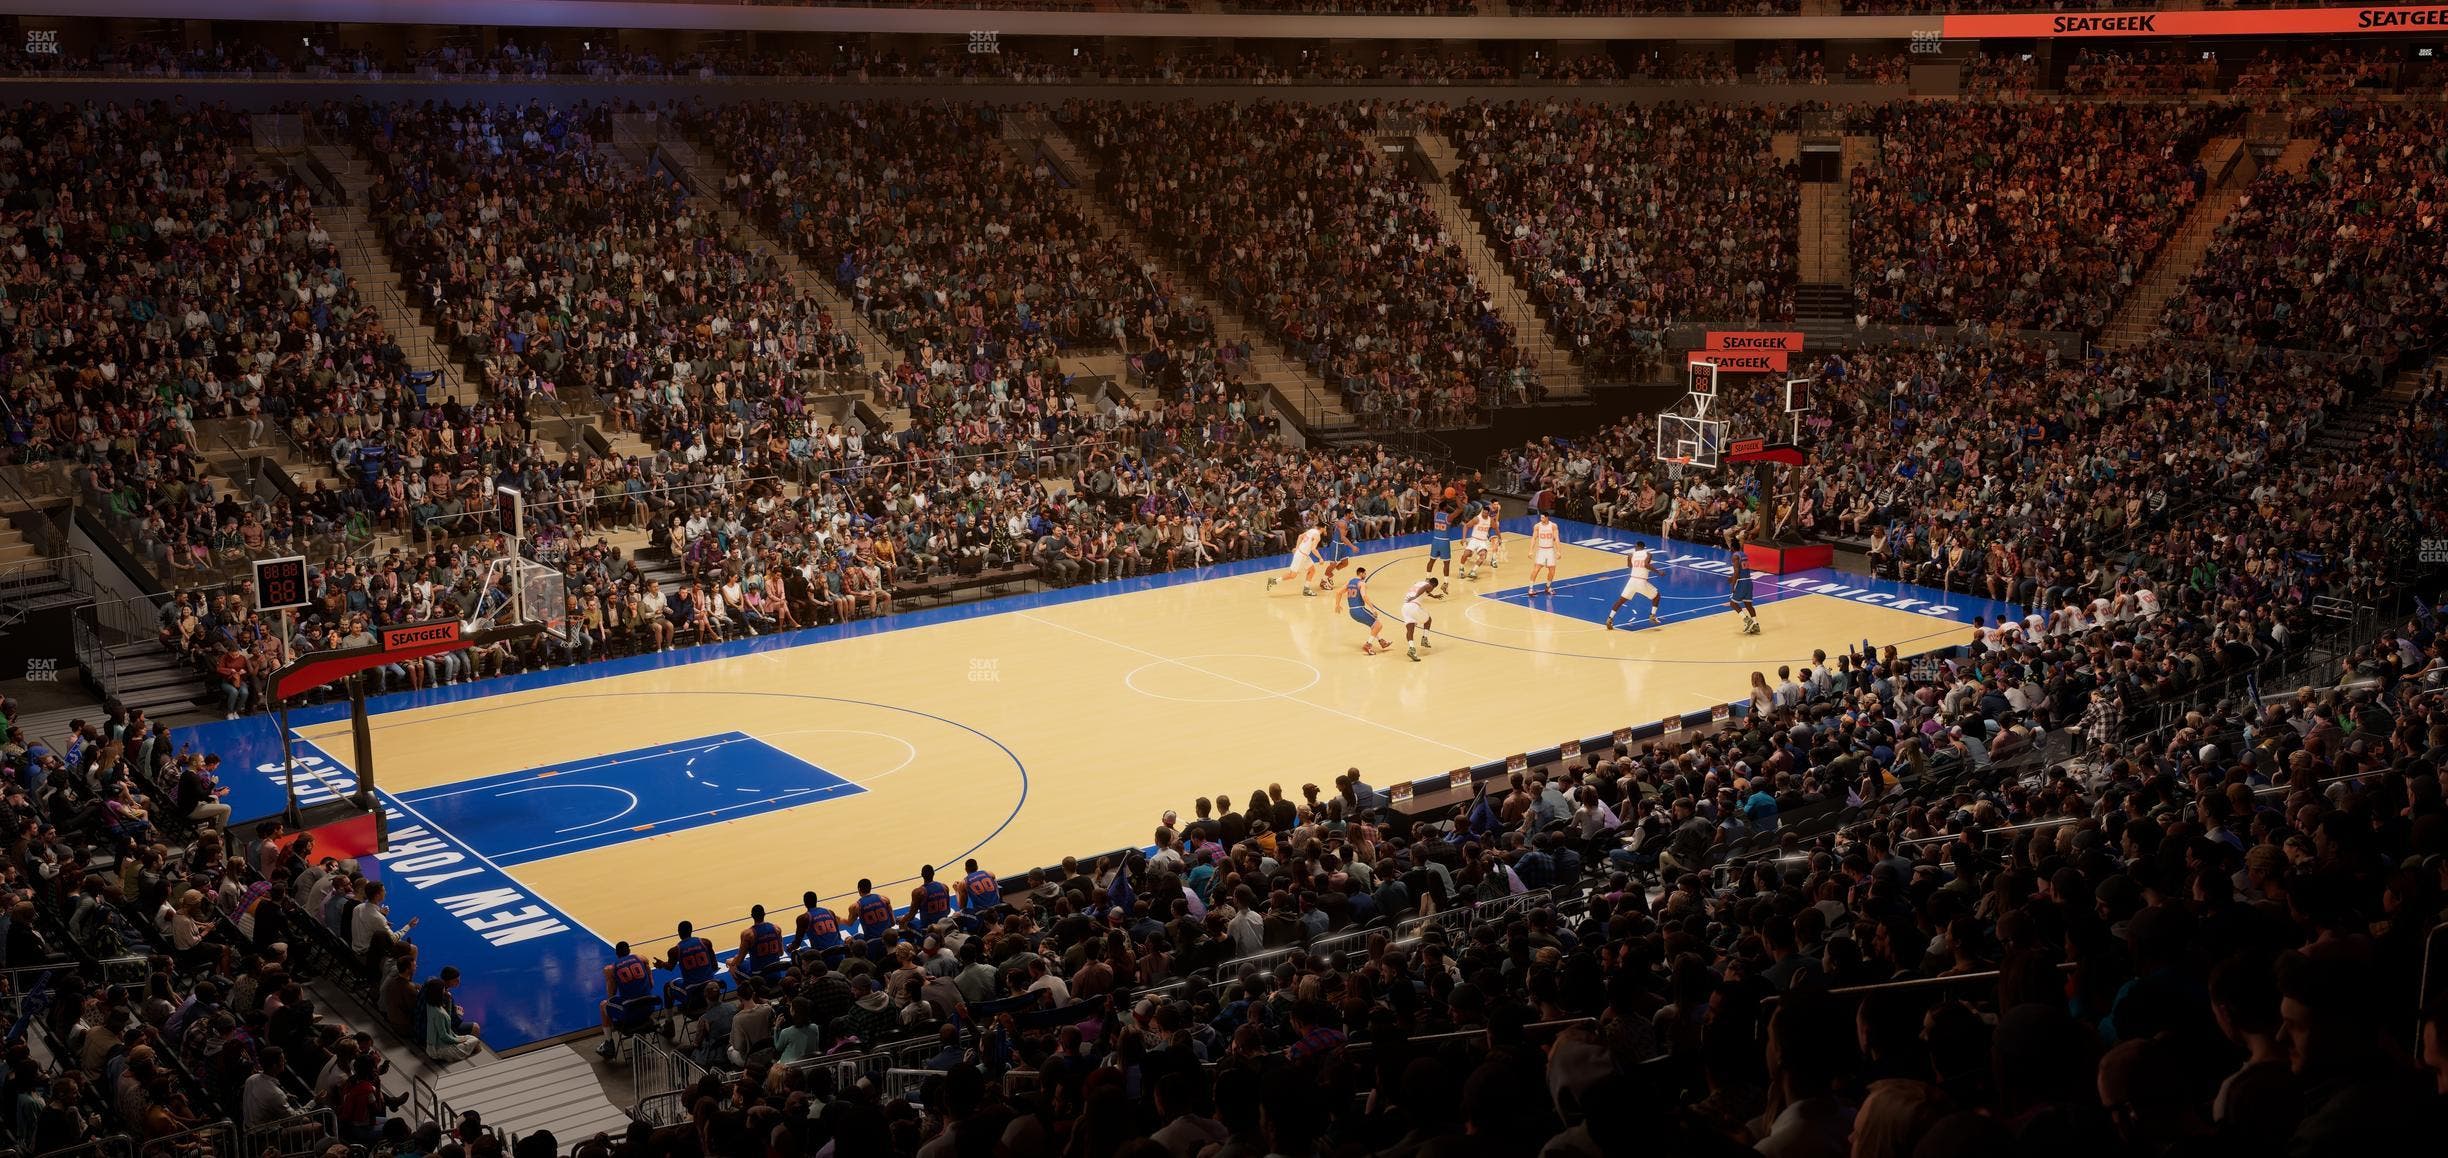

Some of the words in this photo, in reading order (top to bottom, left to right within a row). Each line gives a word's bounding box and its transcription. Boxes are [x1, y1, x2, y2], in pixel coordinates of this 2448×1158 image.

[2053, 15, 2156, 33] SEATGEEK
[1723, 337, 1787, 349] SEATGEEK
[269, 580, 296, 603] 88
[1776, 577, 1959, 616] KNICKS
[392, 626, 452, 646] SEATGEEK
[970, 877, 995, 895] 00
[433, 887, 571, 947] NEW
[863, 907, 889, 925] 00
[814, 920, 837, 936] 00
[683, 952, 708, 970] 00
[617, 963, 645, 984] 00
